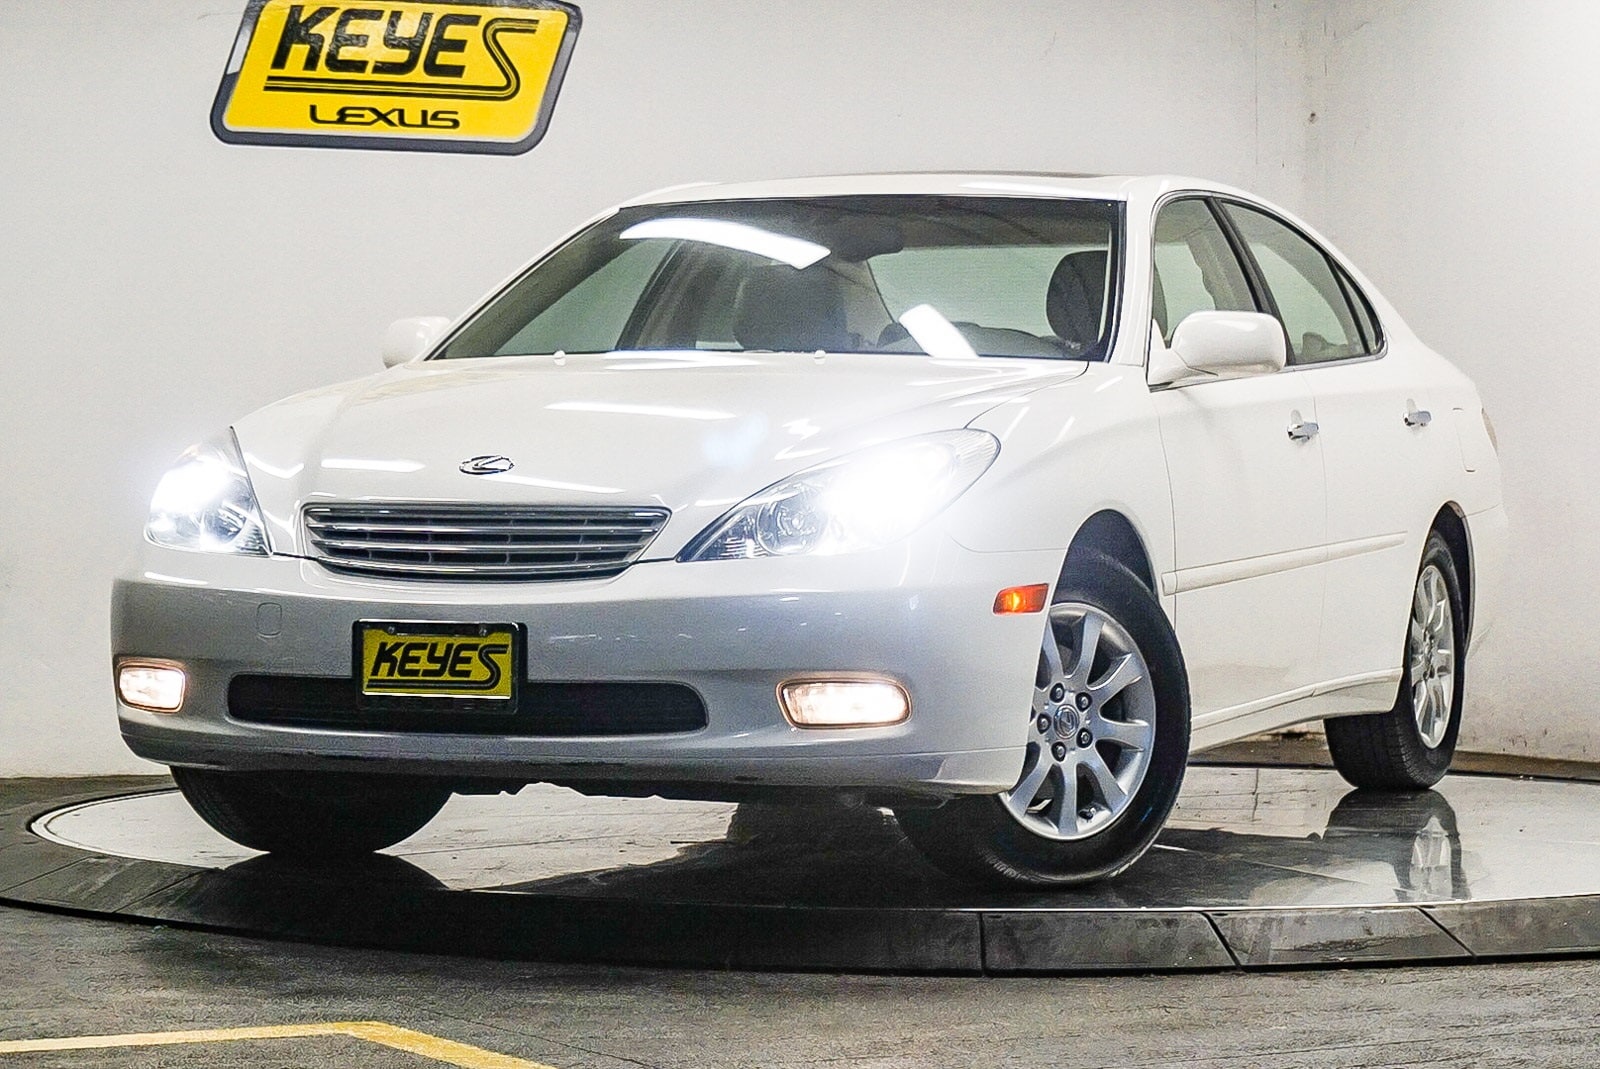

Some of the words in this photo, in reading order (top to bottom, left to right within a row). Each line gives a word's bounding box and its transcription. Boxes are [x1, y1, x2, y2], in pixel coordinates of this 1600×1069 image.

[270, 4, 539, 99] KEYES
[309, 104, 461, 129] LEXUS
[369, 641, 509, 690] KEYES
